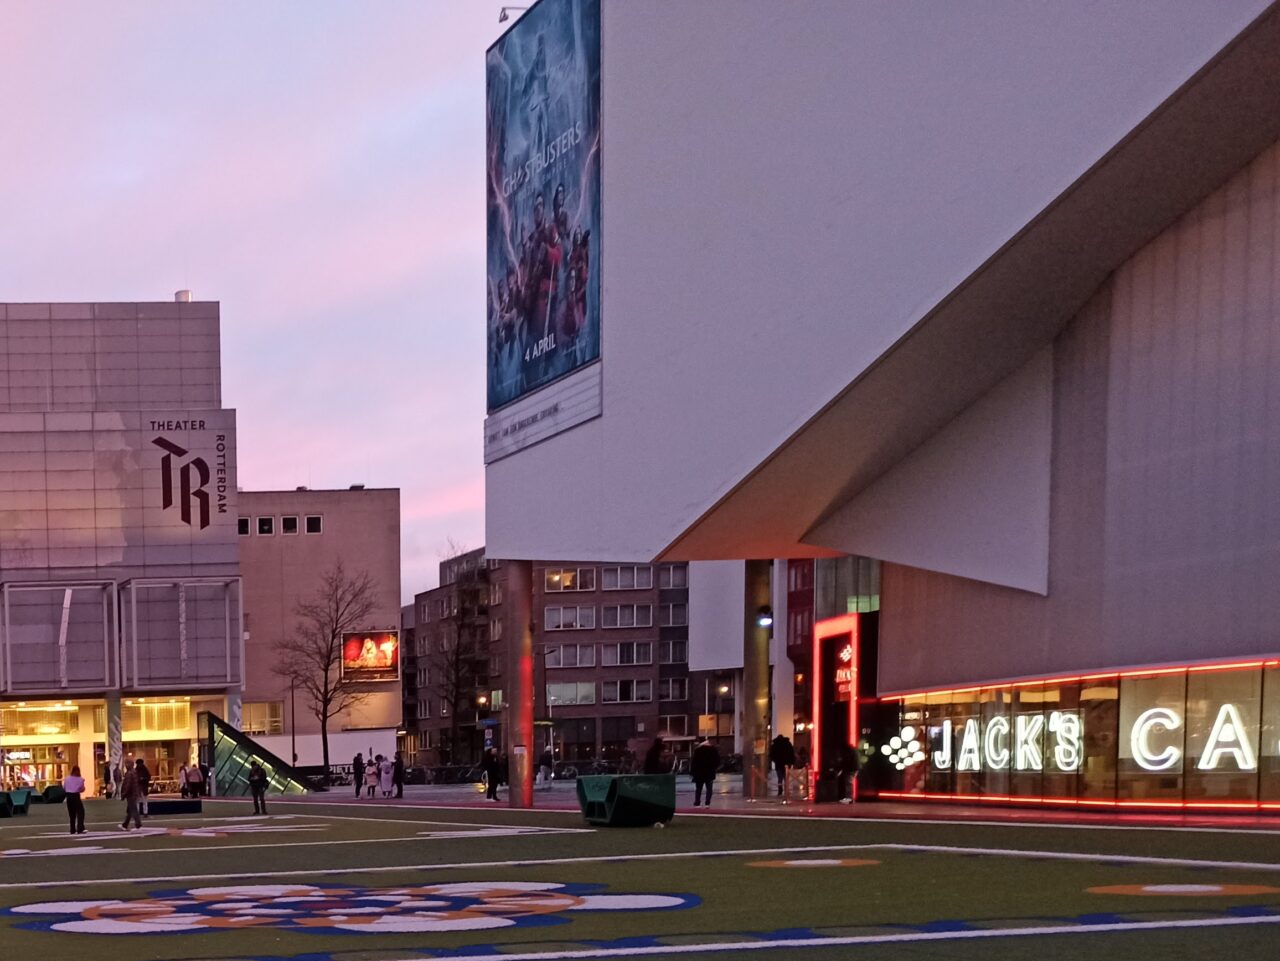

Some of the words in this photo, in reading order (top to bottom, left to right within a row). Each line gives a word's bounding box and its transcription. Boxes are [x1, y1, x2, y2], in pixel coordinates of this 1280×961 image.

[525, 348, 530, 362] 4
[532, 333, 556, 359] APRIL
[150, 420, 206, 431] THEATER
[216, 434, 227, 514] ROTTERDAM
[934, 711, 1080, 771] JACK'S
[1130, 703, 1280, 771] CA
[329, 766, 354, 774] PIETE
